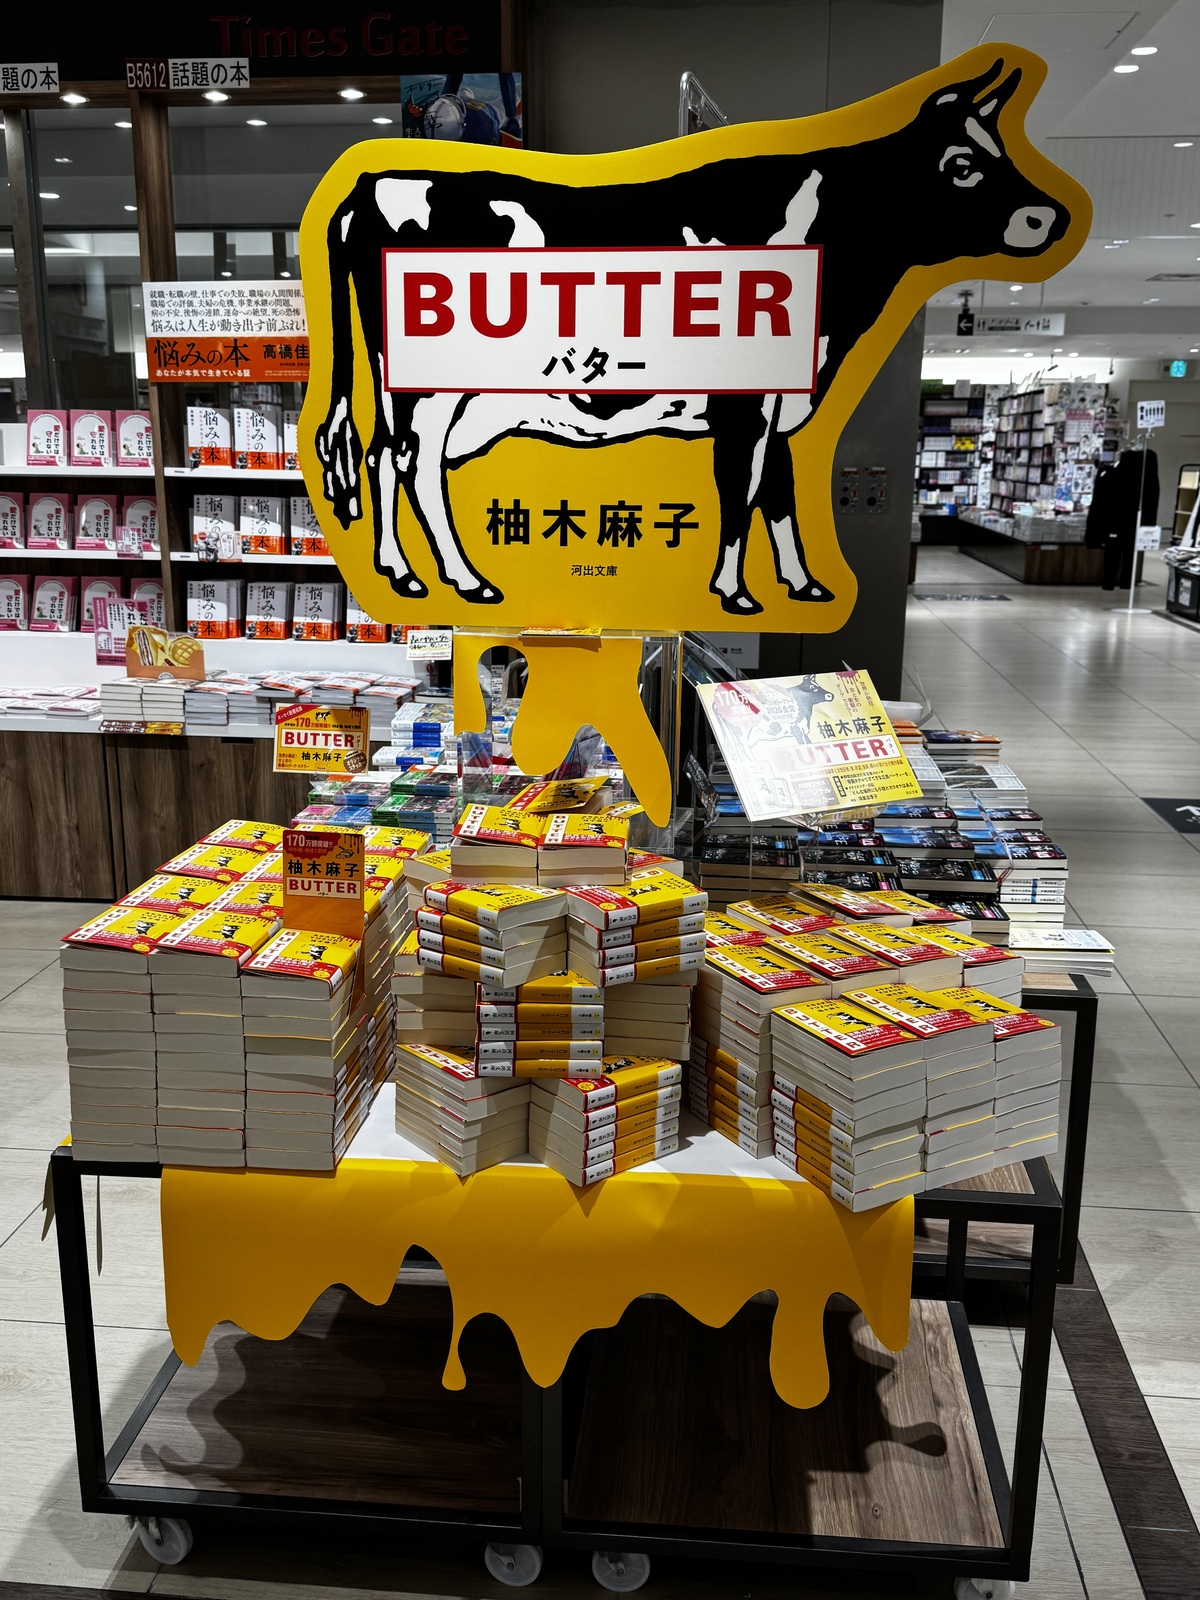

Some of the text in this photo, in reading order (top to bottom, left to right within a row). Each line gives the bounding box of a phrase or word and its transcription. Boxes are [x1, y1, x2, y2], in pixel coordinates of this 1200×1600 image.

[208, 10, 470, 58] Times Gate
[126, 62, 167, 88] B5612
[171, 60, 249, 88] 話題の本
[403, 269, 794, 339] BUTTER
[154, 338, 251, 368] 悩みの本
[541, 346, 646, 384] バター
[203, 410, 221, 463] 悩みの本
[250, 412, 267, 467] 悩みの本
[255, 499, 270, 548] 悩みの本
[486, 498, 700, 549] 柚木麻子
[570, 564, 618, 578] 河出文庫
[201, 583, 216, 635] 悩みの本
[261, 585, 275, 636] 悩みの本
[309, 586, 323, 636] 悩みの本
[285, 731, 355, 748] BUTTER
[817, 715, 886, 739] 柚木麻子
[301, 751, 342, 762] 柚木麻子
[288, 859, 360, 878] 柚木麻子
[289, 878, 357, 894] BUTTER
[784, 1008, 861, 1049] BUTTER
[856, 992, 933, 1032] BUTTER
